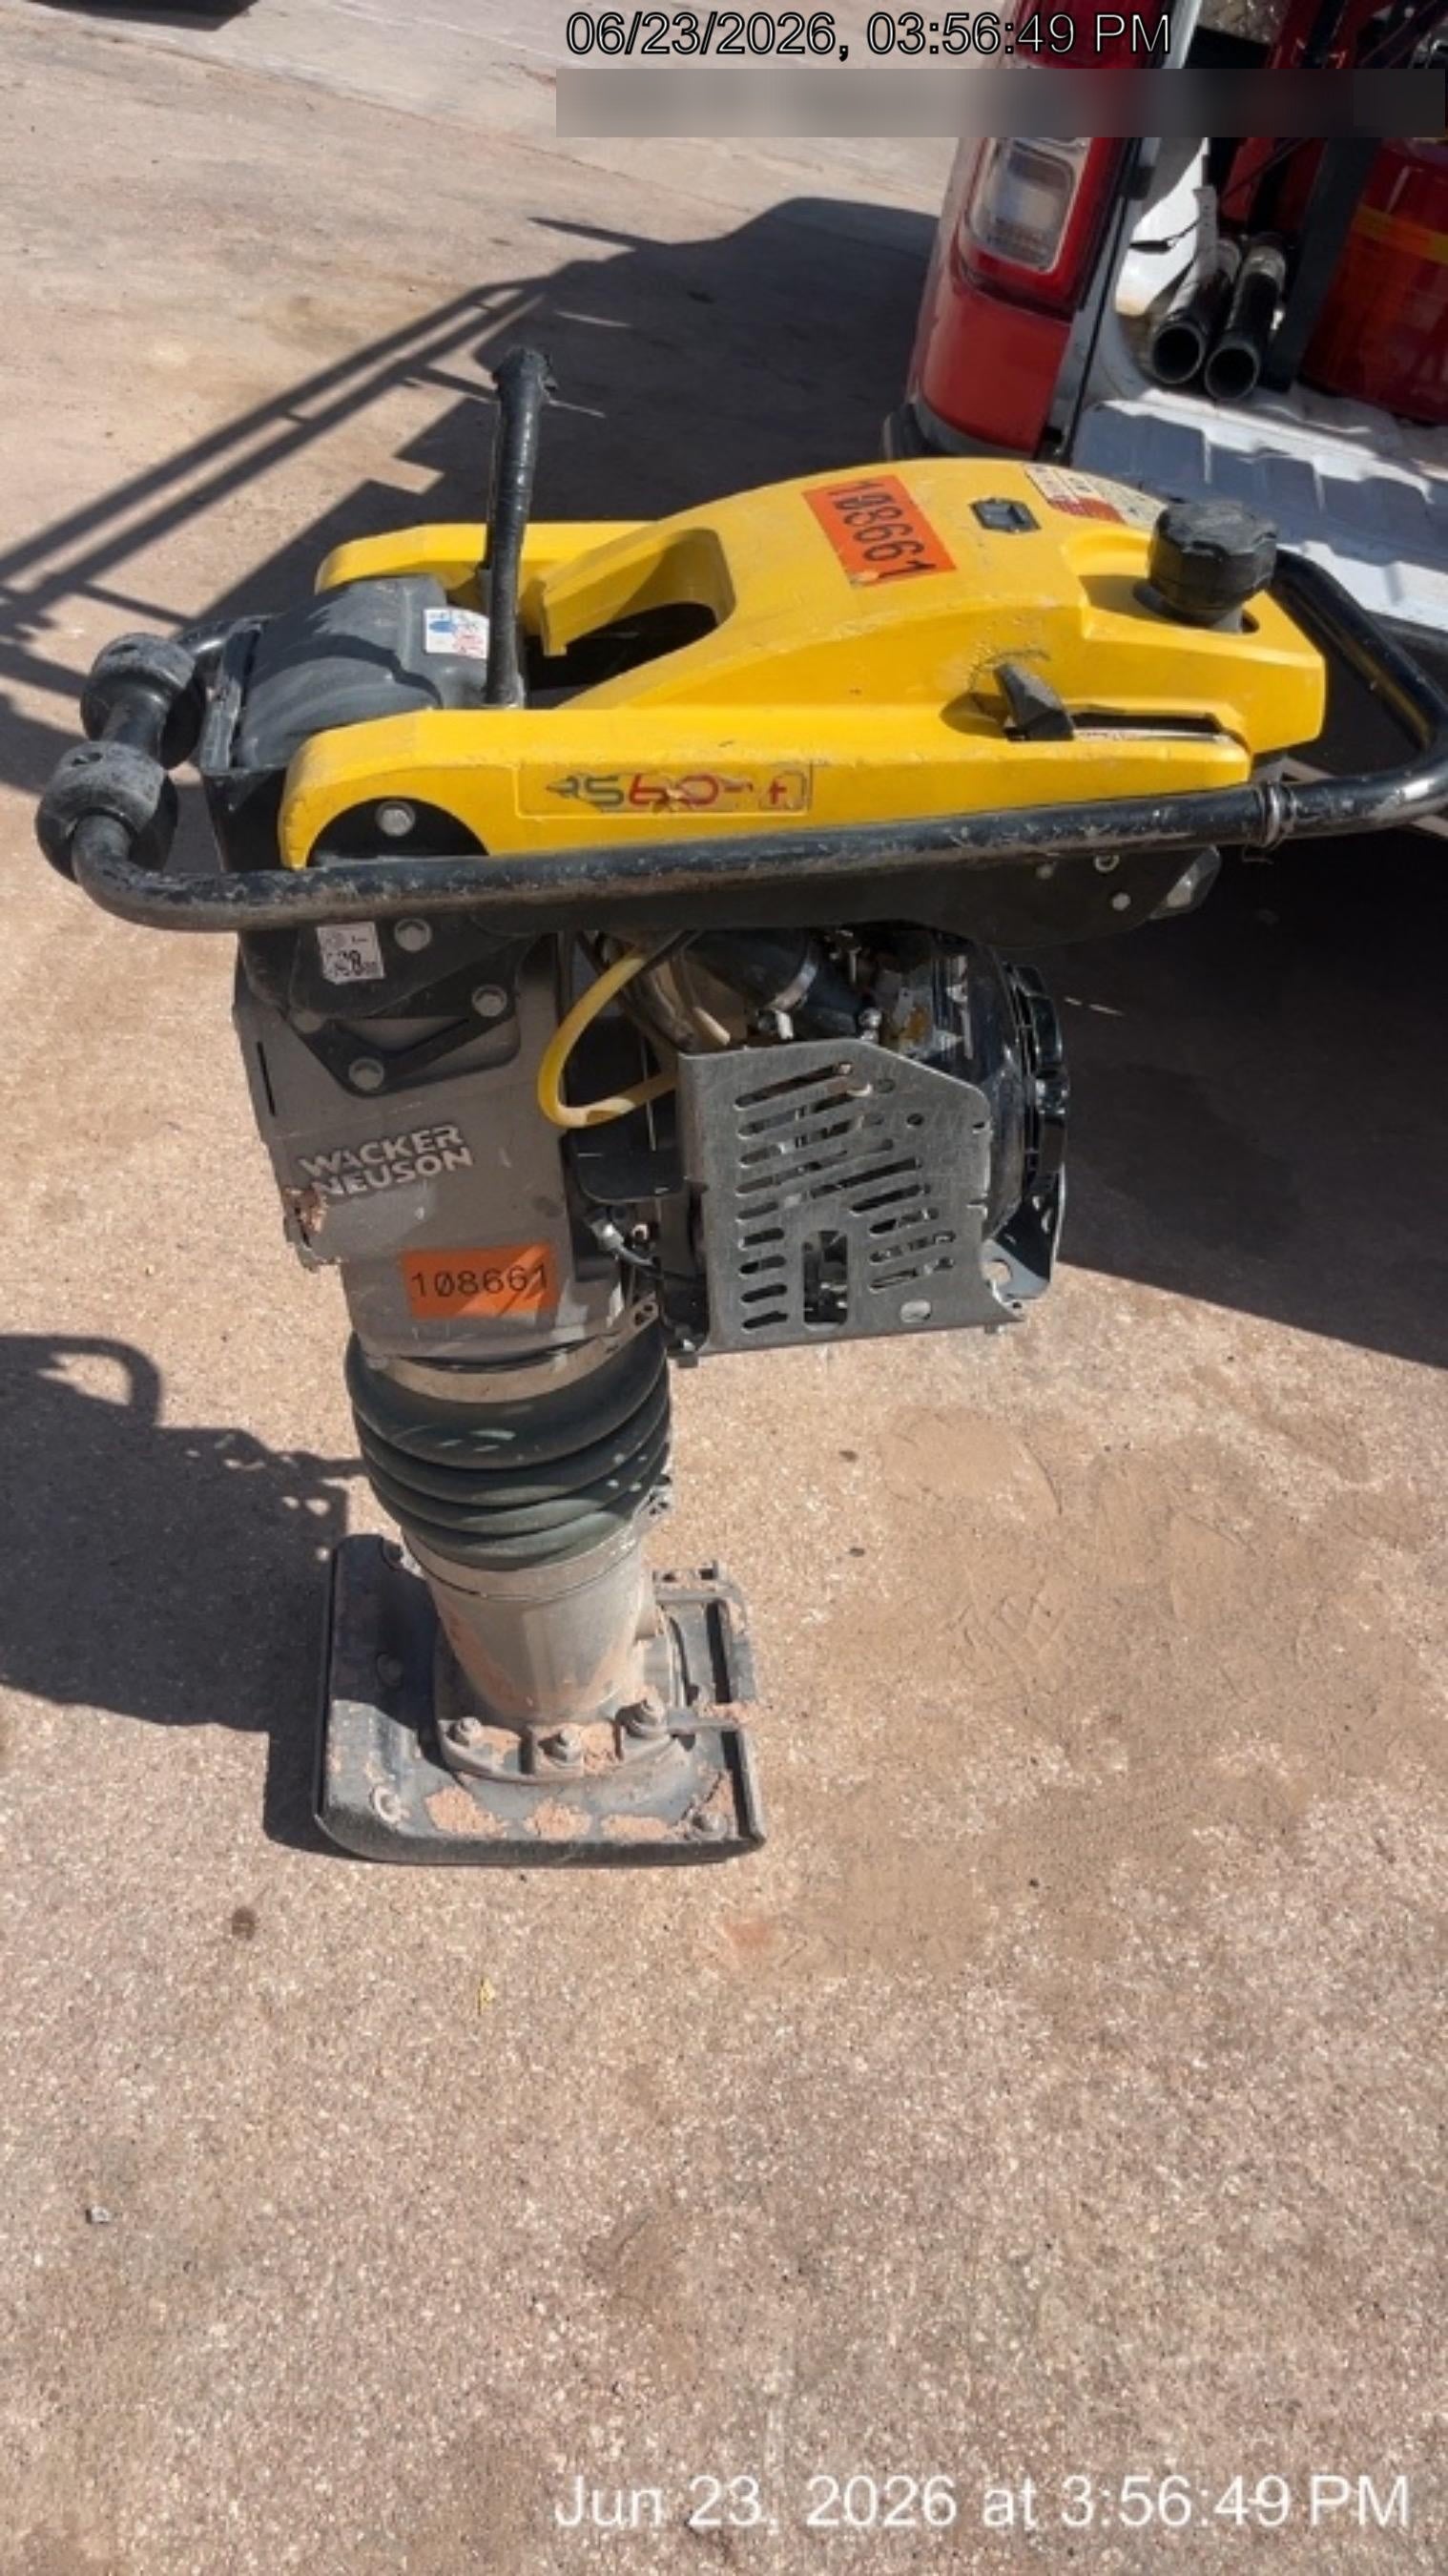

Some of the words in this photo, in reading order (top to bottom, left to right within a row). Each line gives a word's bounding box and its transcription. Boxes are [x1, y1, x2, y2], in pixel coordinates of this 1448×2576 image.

[827, 479, 938, 579] 108661
[299, 1123, 464, 1176] WACKER
[312, 1147, 474, 1195] NEUSON
[411, 1263, 548, 1298] 108661
